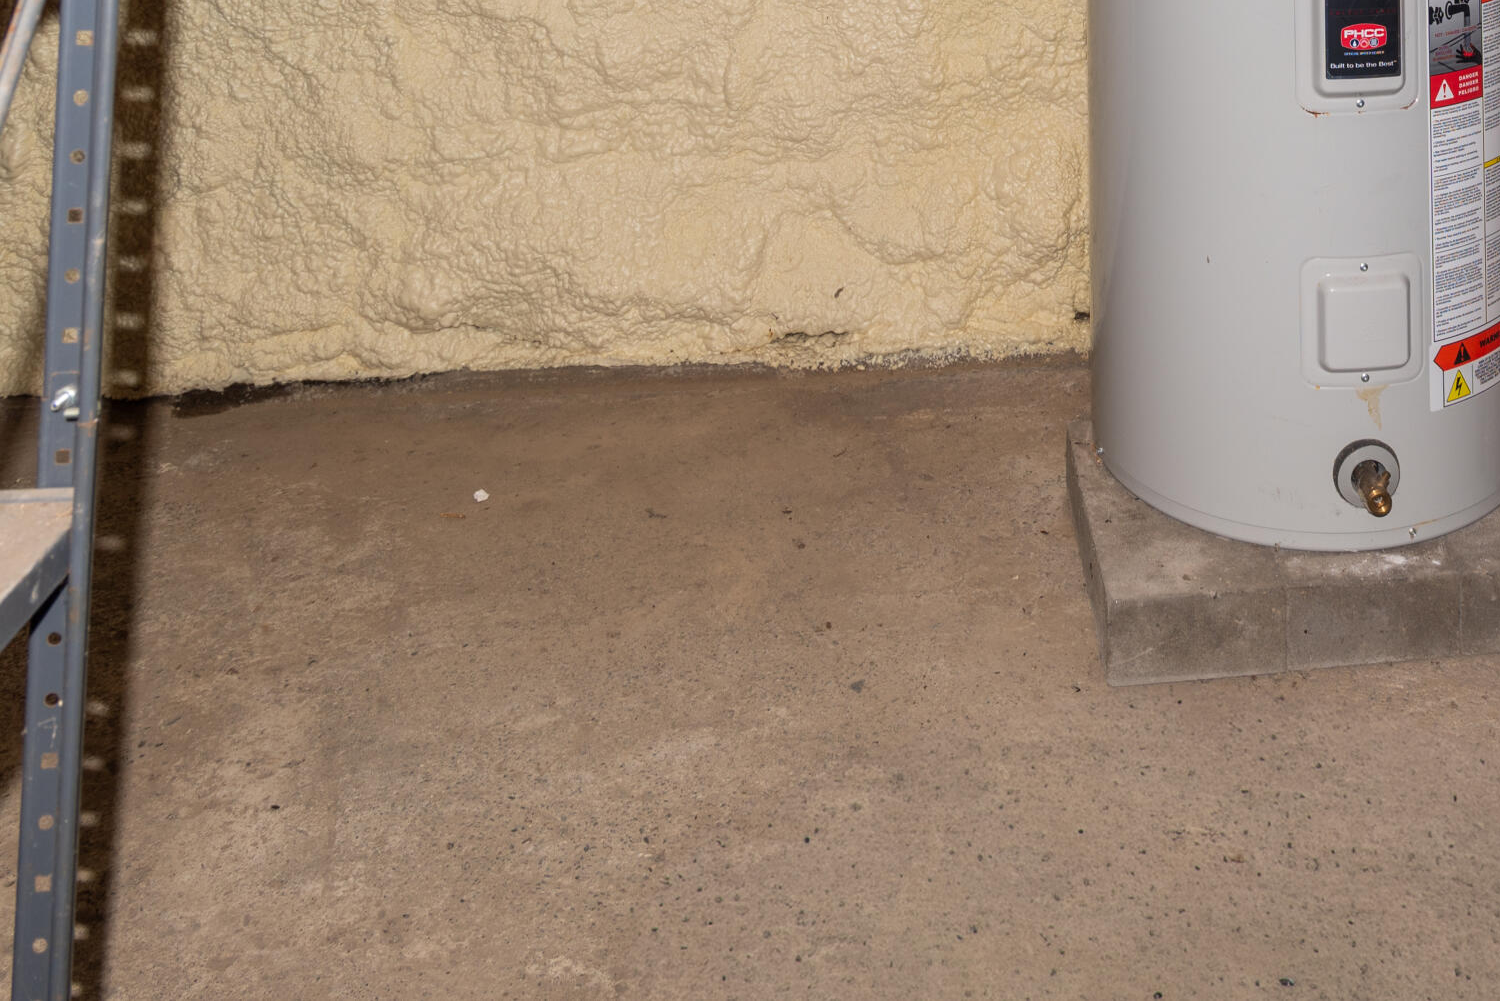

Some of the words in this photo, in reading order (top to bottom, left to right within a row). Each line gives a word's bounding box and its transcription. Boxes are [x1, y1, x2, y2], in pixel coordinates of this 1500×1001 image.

[1343, 28, 1385, 39] PHCC
[1458, 71, 1479, 81] DANGER
[1458, 79, 1479, 89] DANGER
[1458, 86, 1480, 96] PELIGRO
